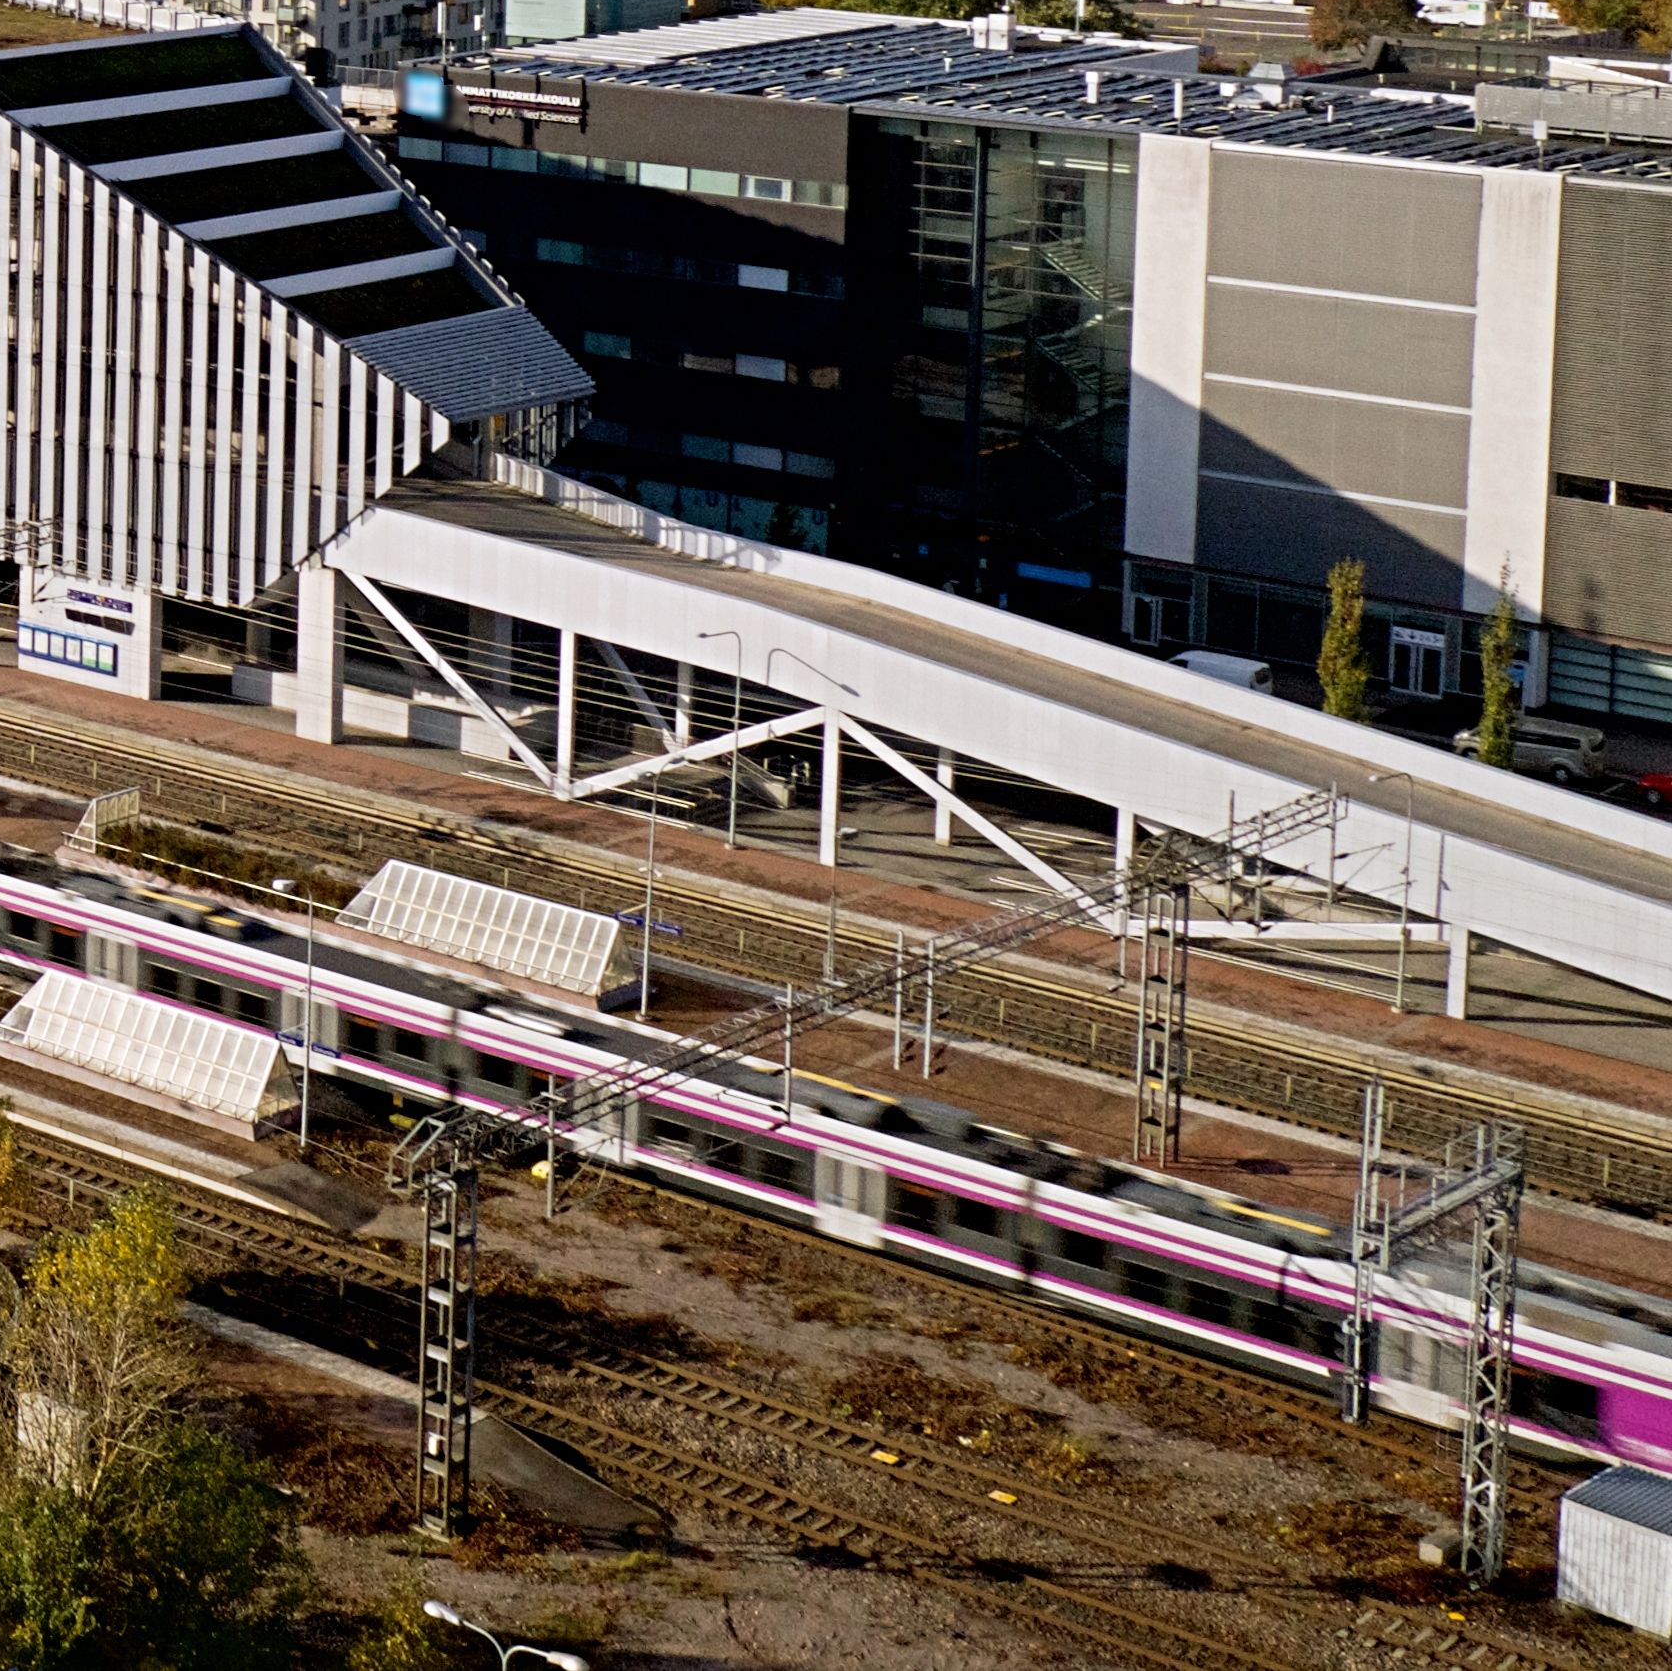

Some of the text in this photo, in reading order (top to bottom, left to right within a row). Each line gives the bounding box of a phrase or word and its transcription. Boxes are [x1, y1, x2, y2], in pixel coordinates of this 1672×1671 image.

[469, 105, 495, 117] ersity
[496, 106, 507, 116] of
[540, 111, 579, 124] Sciences
